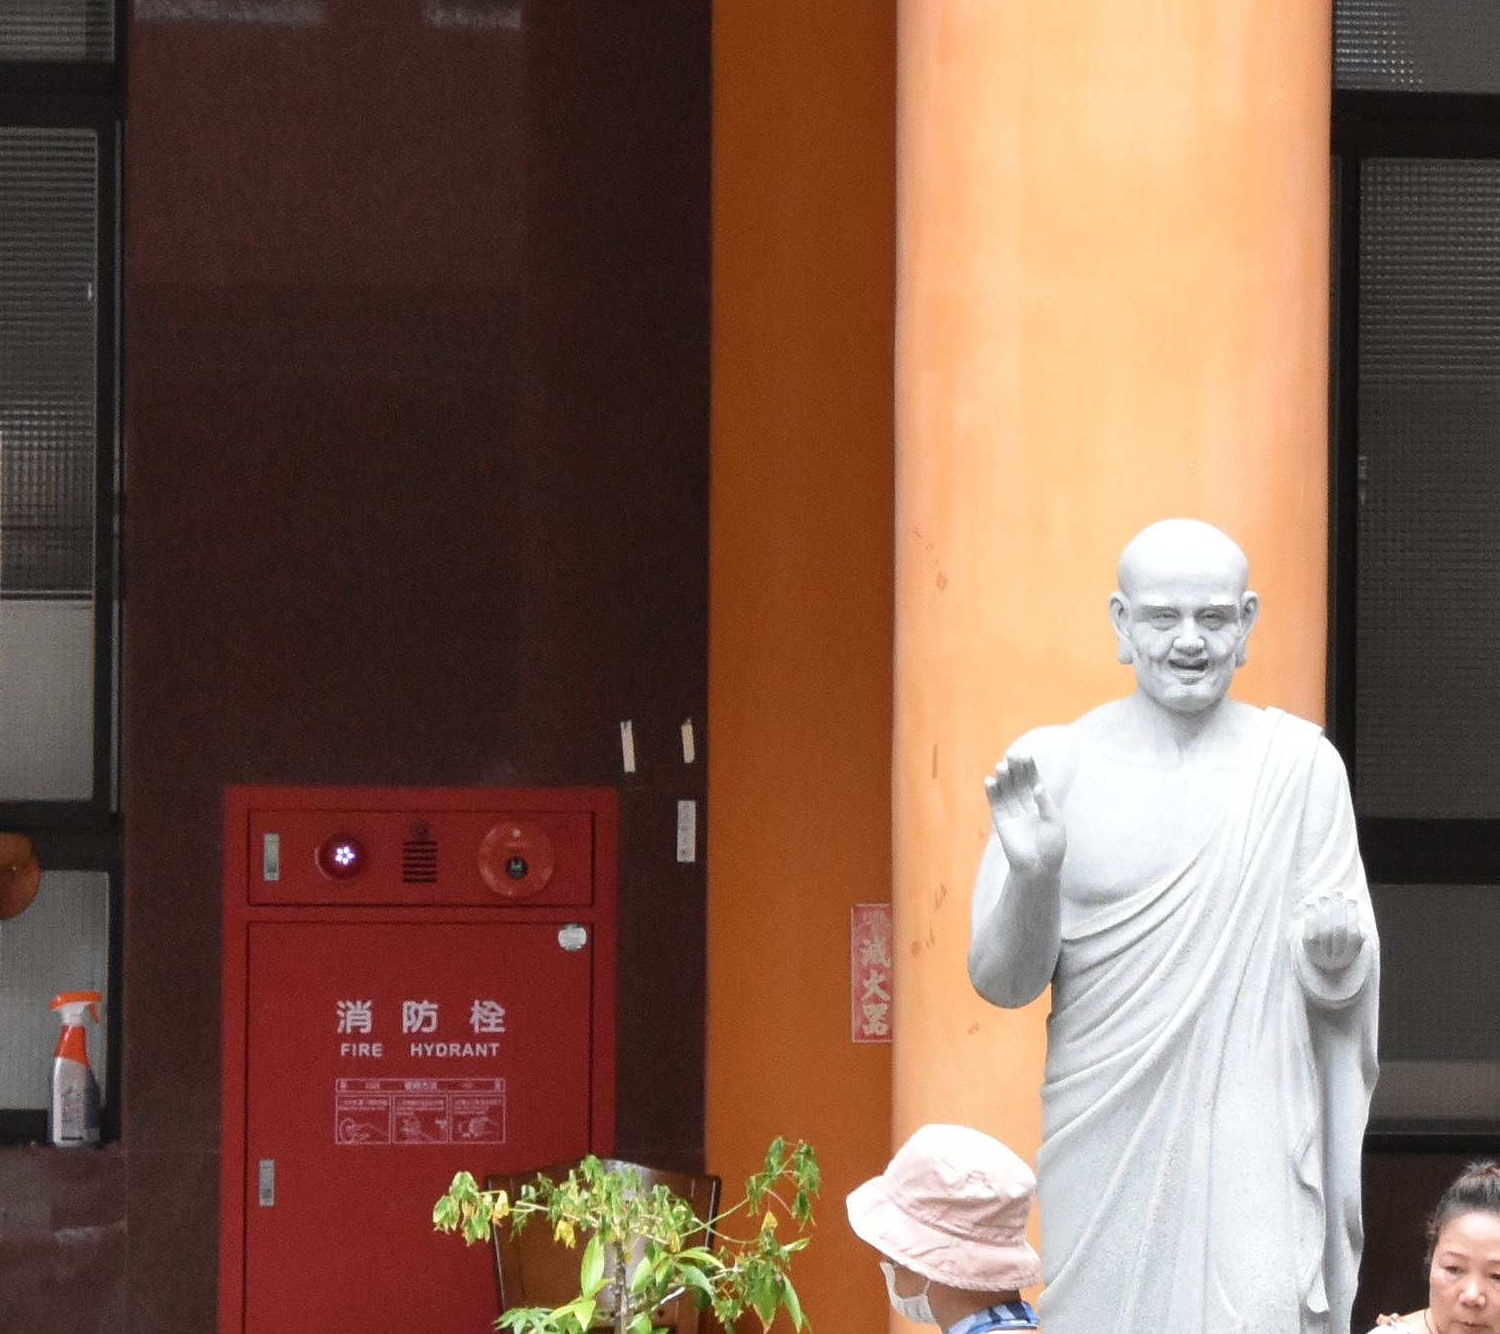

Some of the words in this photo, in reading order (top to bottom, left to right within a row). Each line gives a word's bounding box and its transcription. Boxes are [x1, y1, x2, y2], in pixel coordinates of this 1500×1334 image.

[337, 1000, 506, 1034] 消防栓
[341, 1043, 383, 1057] FIRE
[410, 1043, 501, 1057] HYDRANT
